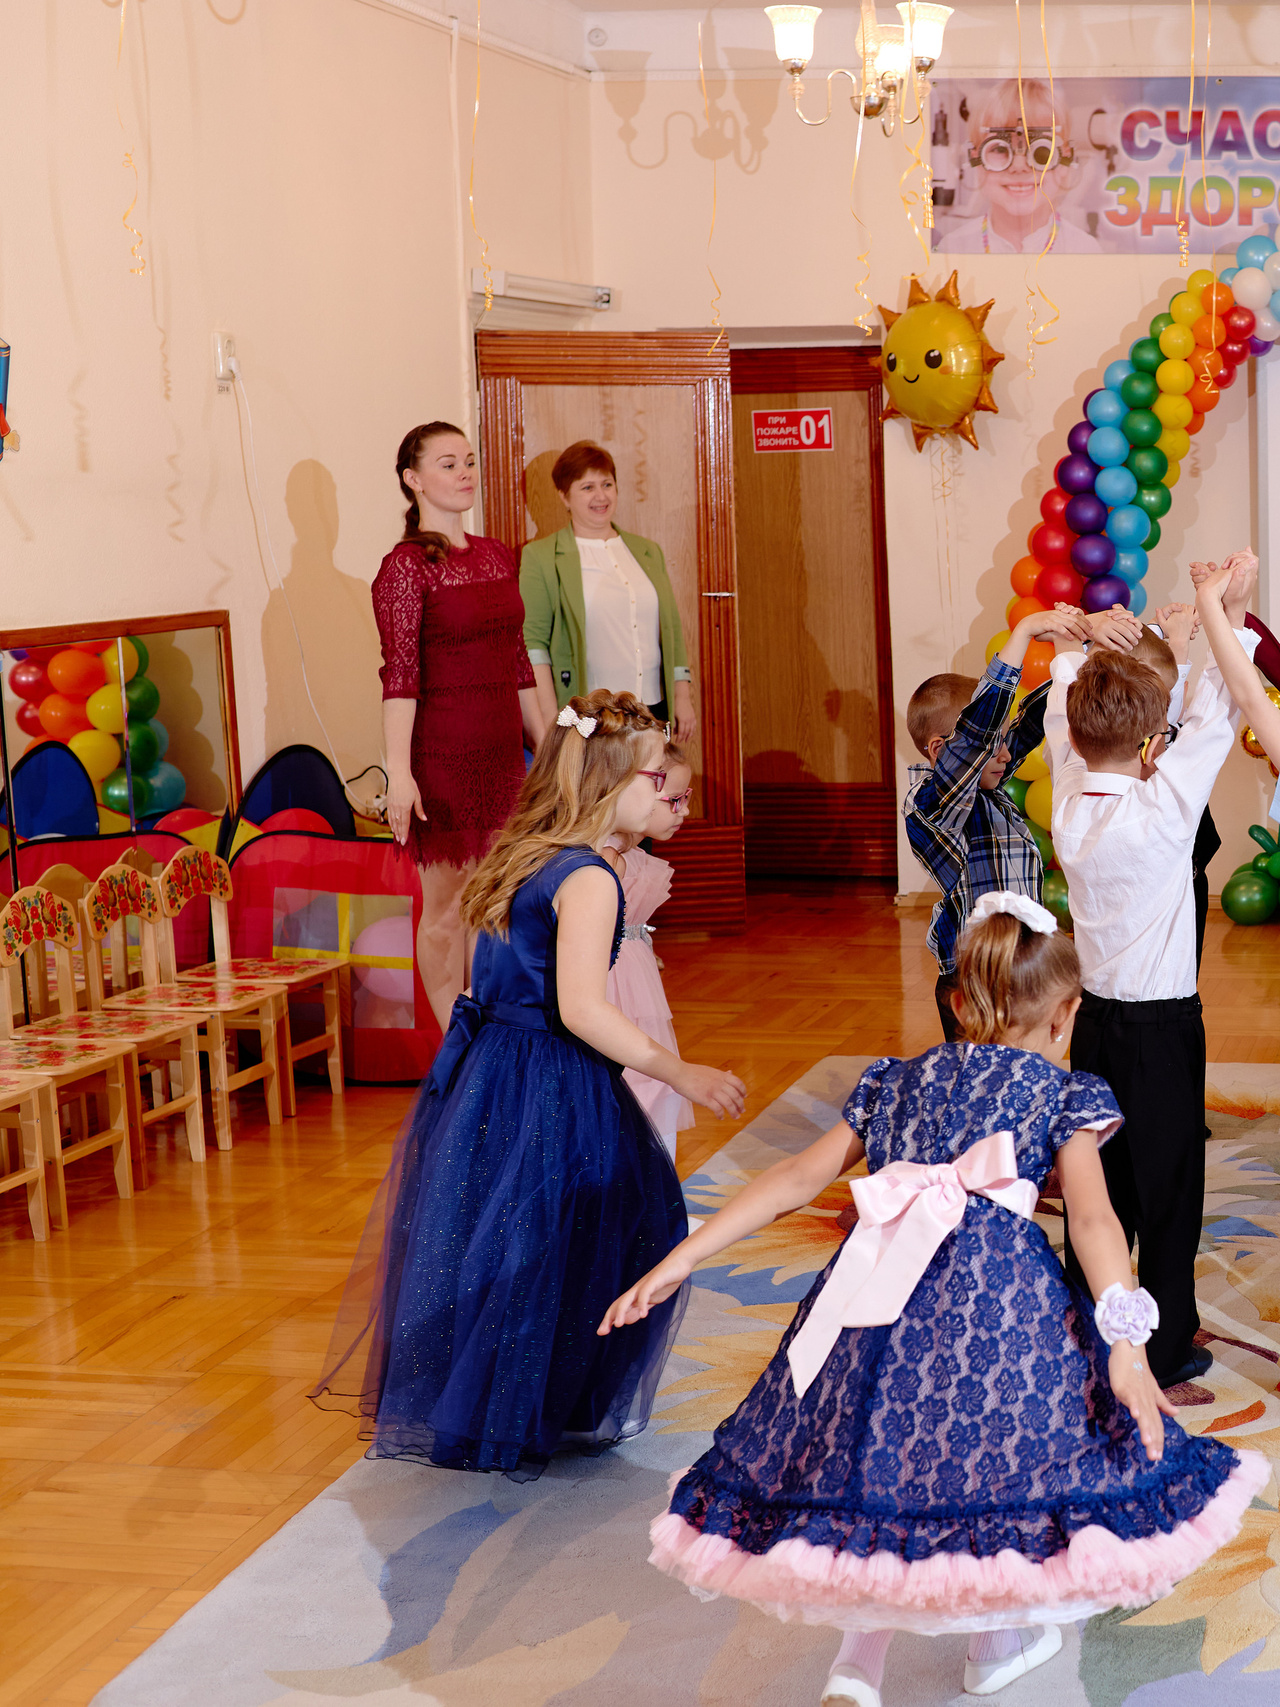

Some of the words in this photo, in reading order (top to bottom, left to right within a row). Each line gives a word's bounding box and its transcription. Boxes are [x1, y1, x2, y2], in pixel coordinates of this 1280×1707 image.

[768, 416, 786, 425] ПРИ
[756, 426, 799, 436] ПОЖАРЕ
[800, 414, 830, 446] 01
[757, 437, 800, 447] ЗВОНИТЬ
